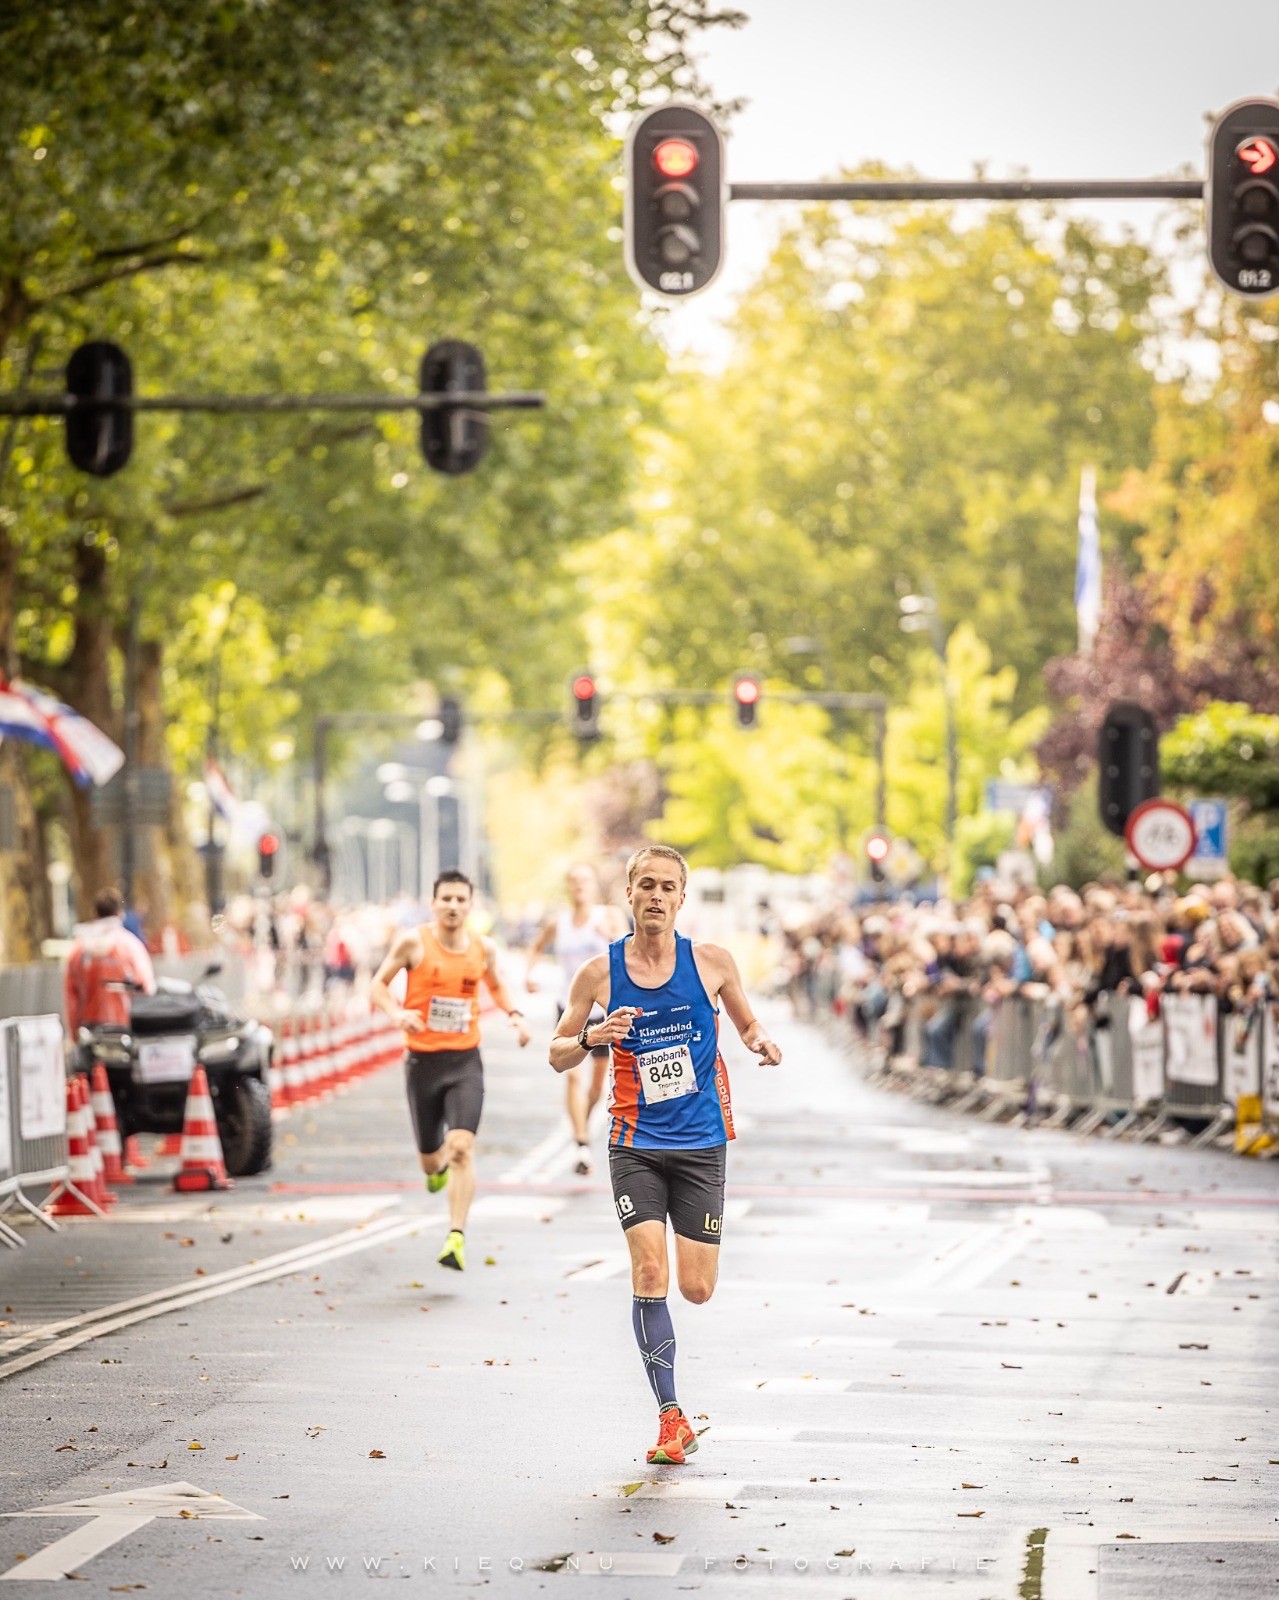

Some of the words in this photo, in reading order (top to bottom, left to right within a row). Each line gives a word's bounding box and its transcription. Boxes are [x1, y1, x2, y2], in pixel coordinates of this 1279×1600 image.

[639, 1021, 692, 1036] Klaverblad
[640, 1032, 693, 1045] Verzekeringen
[639, 1047, 687, 1068] Rabobank
[649, 1061, 683, 1083] 849
[657, 1080, 681, 1090] Thomas
